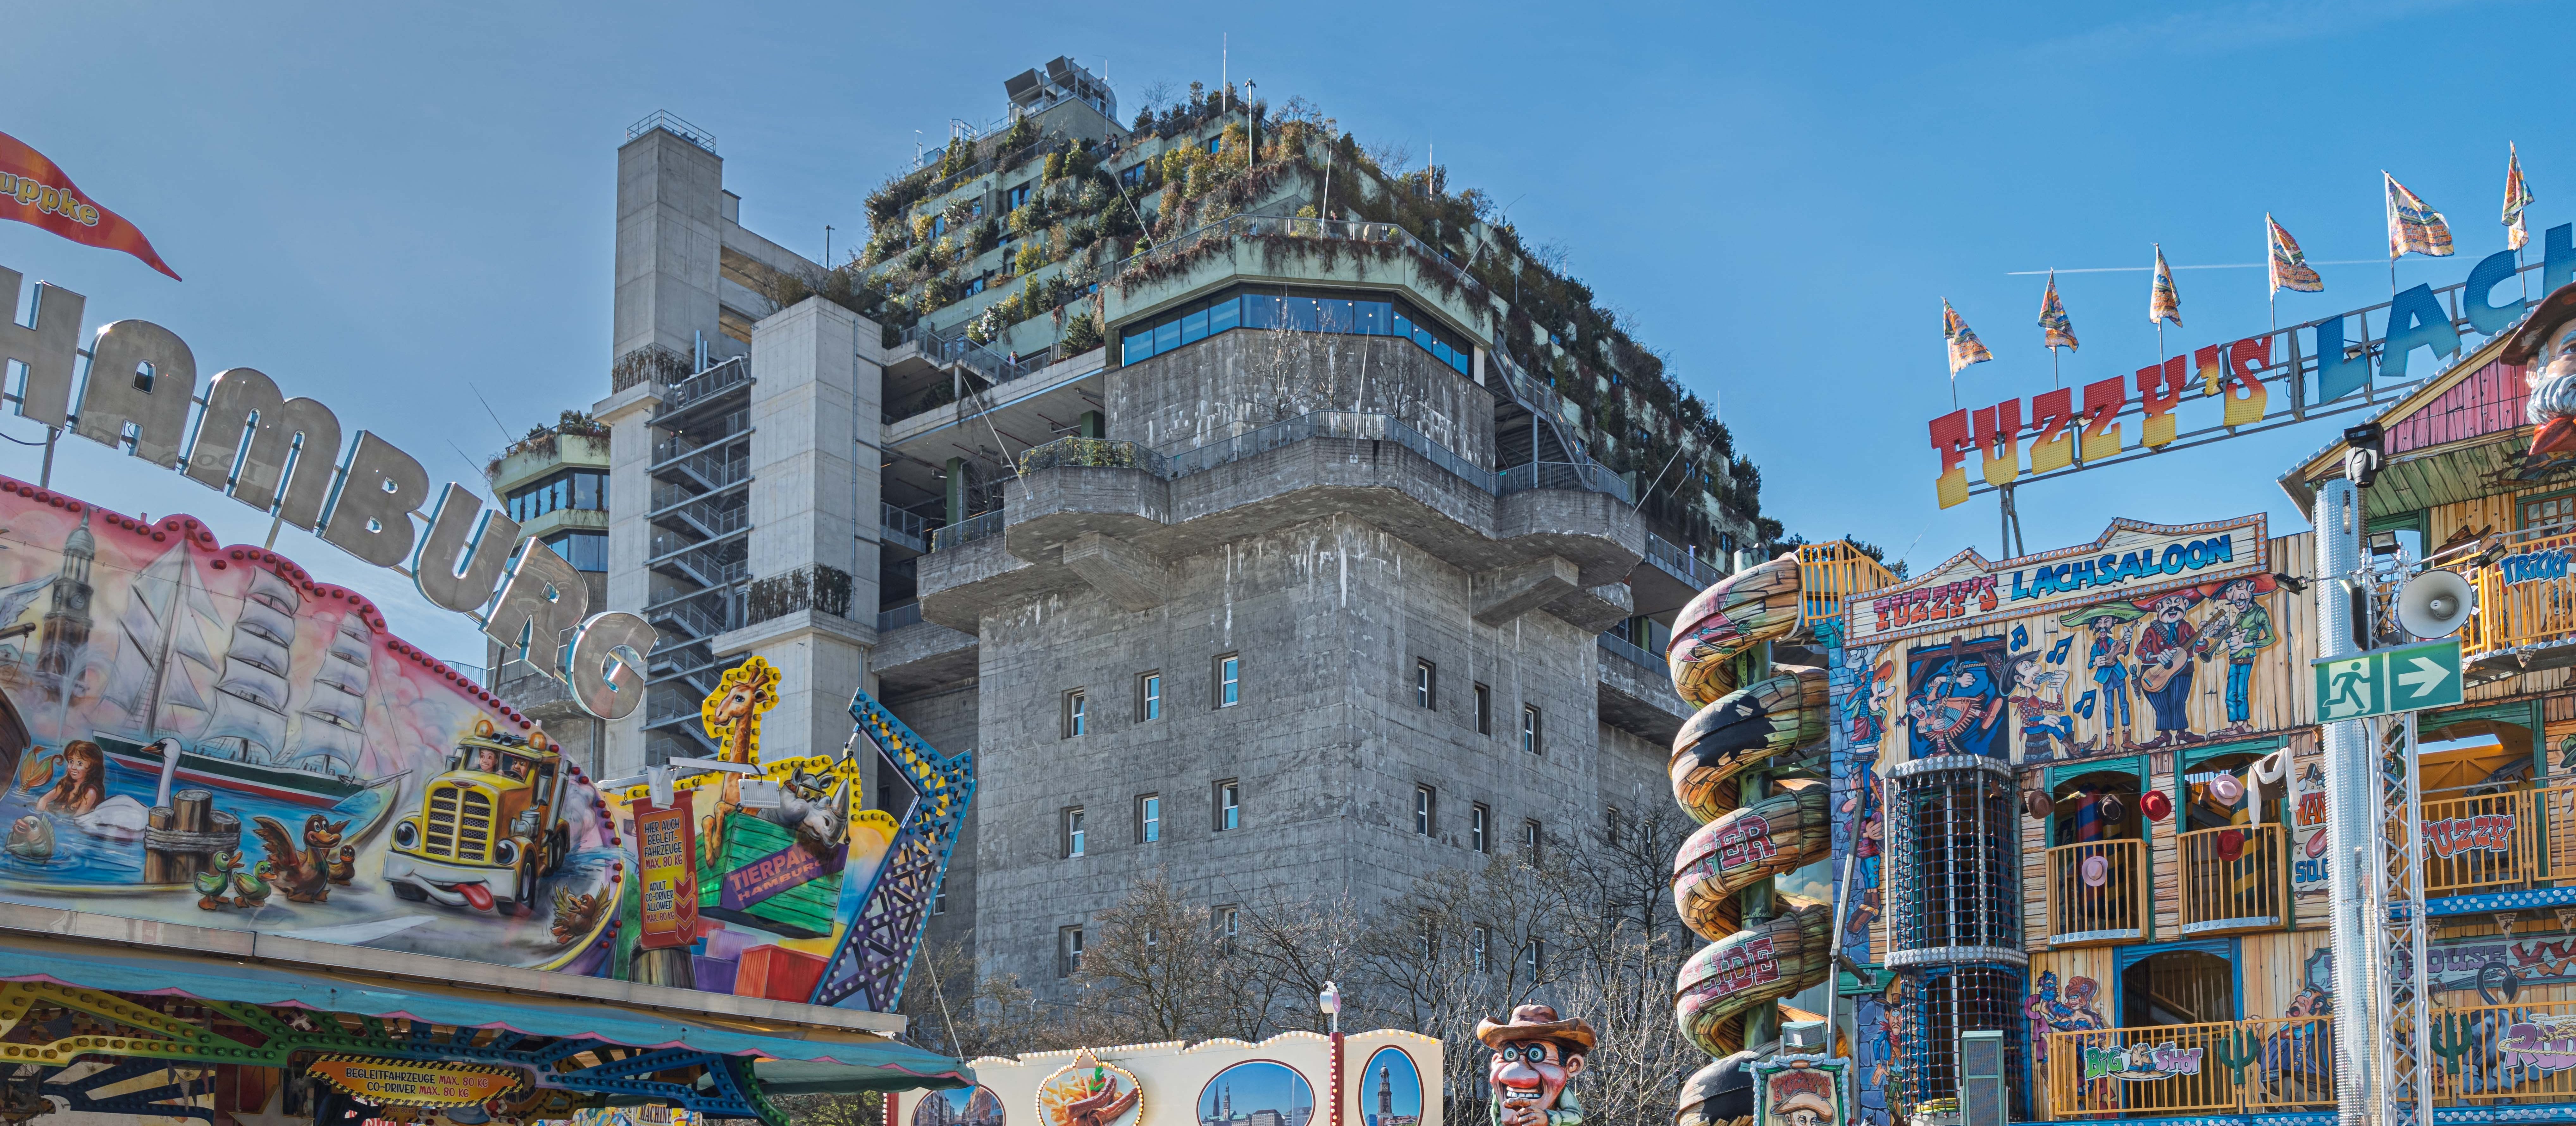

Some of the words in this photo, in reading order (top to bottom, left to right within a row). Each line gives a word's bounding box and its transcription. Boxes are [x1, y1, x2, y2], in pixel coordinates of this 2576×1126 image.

[1928, 336, 2273, 510] FUZZY'S
[0, 265, 659, 720] HAMBURG
[1873, 573, 1998, 632] FUZZY'S
[2011, 534, 2233, 601] LACHSALOON
[2295, 792, 2326, 826] WAN
[644, 821, 659, 834] HIER
[661, 818, 679, 831] AUCH
[647, 831, 678, 846] BEGLEIT-
[644, 842, 683, 857] FAHRZEUGE
[645, 858, 661, 870] MAX.
[663, 857, 672, 867] 80
[674, 855, 683, 865] KG
[649, 881, 666, 892] ADULT
[645, 890, 674, 902] CO-DRIVER
[647, 900, 672, 912] ALLOWED
[647, 913, 659, 923] MAX.
[660, 912, 667, 921] 80
[668, 911, 675, 920] KG
[1681, 937, 1781, 1015] SLIDE
[346, 1067, 436, 1084] BEGLEITFAHRZEUGE
[438, 1075, 460, 1086] MAX.
[463, 1076, 474, 1086] 80
[477, 1078, 488, 1087] KG
[367, 1082, 416, 1094] CO-DRIVER
[419, 1085, 440, 1096] MAX.
[443, 1086, 455, 1097] 80
[458, 1087, 469, 1098] KG
[639, 1105, 672, 1124] MACHINE
